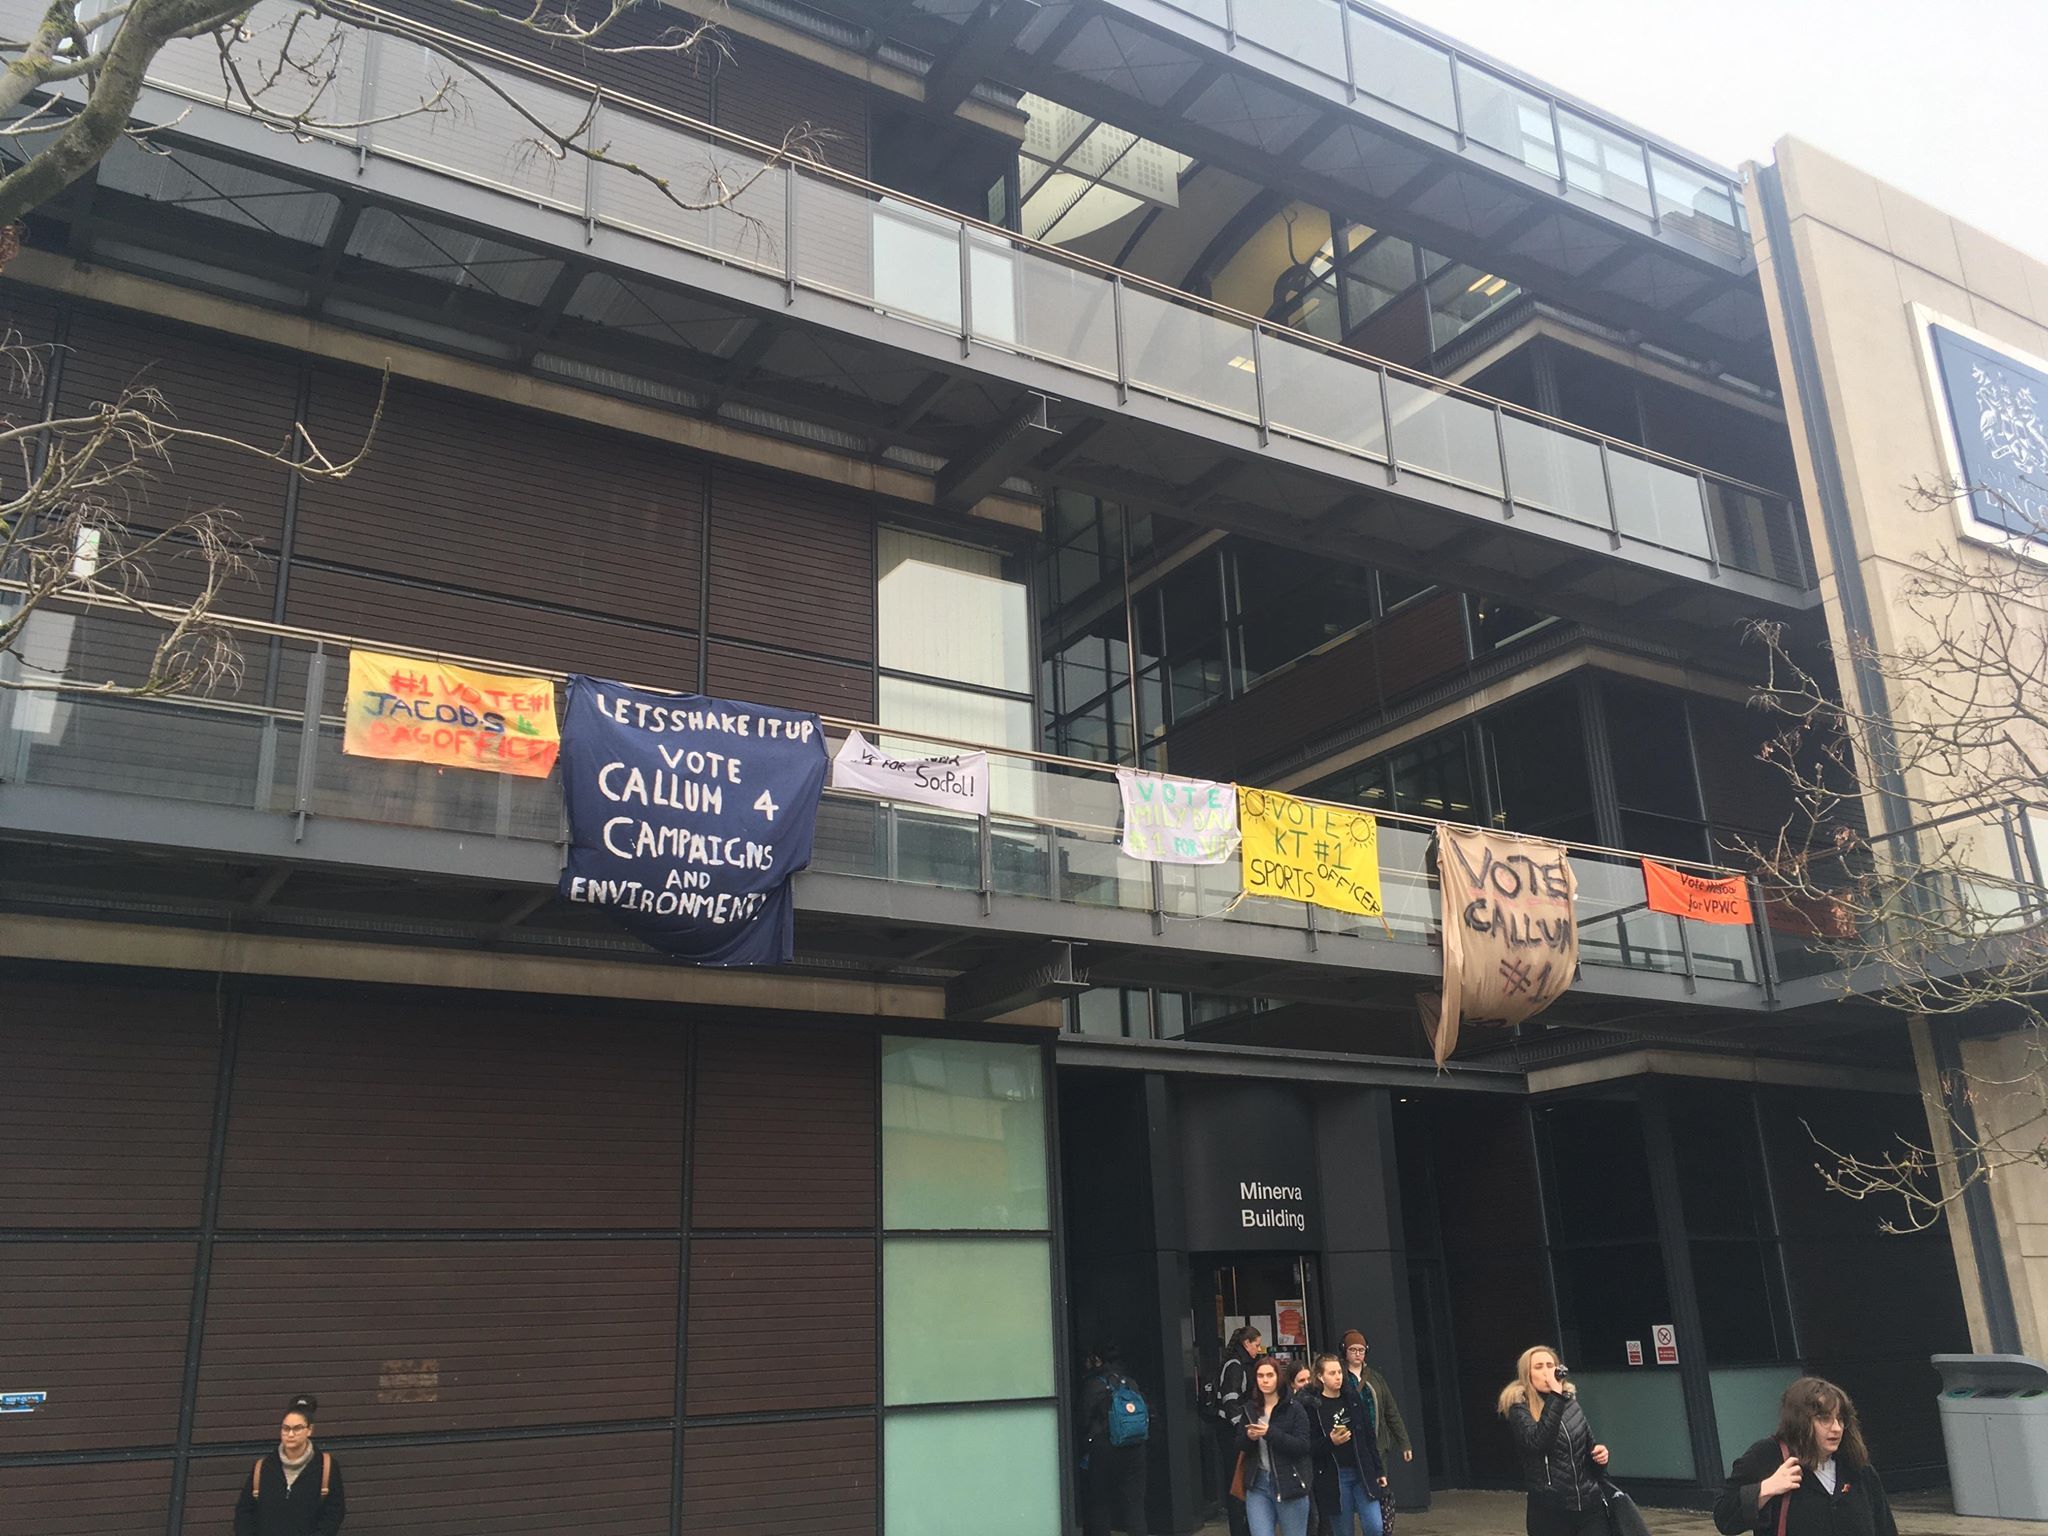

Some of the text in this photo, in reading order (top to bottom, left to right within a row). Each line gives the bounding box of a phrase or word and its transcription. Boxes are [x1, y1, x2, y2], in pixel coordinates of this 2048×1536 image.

[438, 675, 530, 712] VOTE
[432, 728, 561, 760] OFFICER
[758, 717, 782, 739] IT
[785, 719, 814, 744] UP
[657, 744, 742, 784] VOTE
[598, 762, 780, 821] CALLUM 4
[1135, 780, 1223, 809] VOTE
[1271, 797, 1345, 840] VOTE
[602, 816, 774, 871] CAMPAIGNS
[1274, 827, 1352, 871] KT #1
[665, 868, 711, 890] AND
[1250, 858, 1381, 914] SPORTS OFFICER
[1451, 837, 1571, 901] VOTE
[1703, 898, 1739, 915] VPWC
[1239, 1182, 1303, 1201] Minerva
[1241, 1208, 1305, 1232] Building
